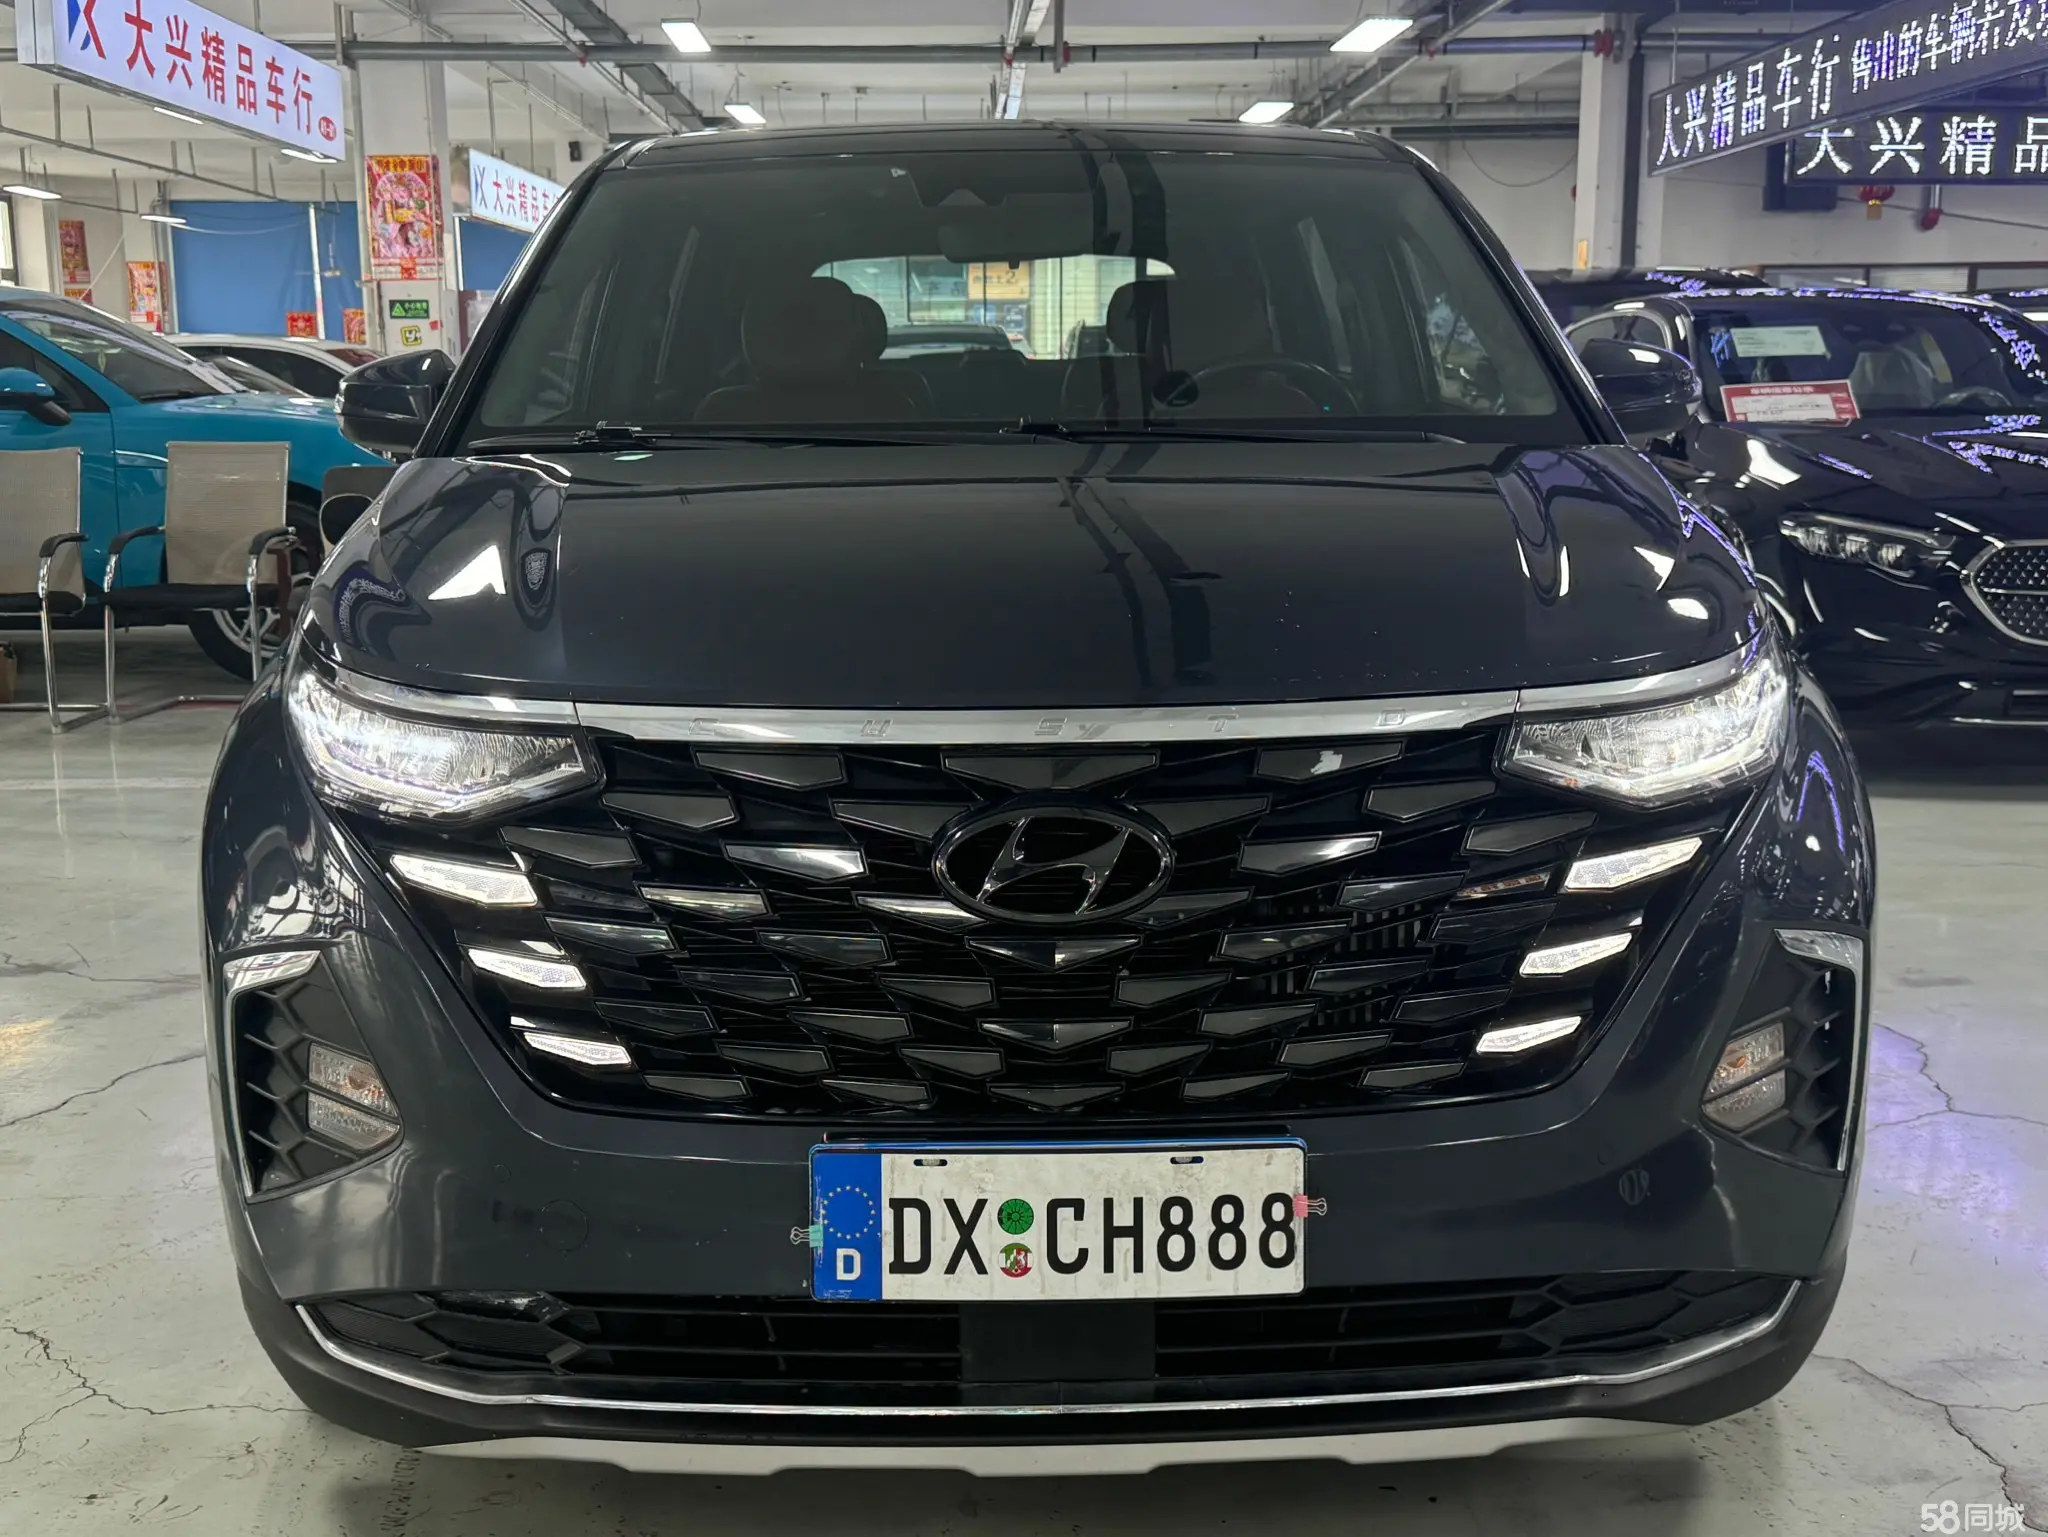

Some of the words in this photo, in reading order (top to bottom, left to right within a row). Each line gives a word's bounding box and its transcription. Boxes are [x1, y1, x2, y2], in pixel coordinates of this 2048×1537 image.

[124, 0, 313, 136] 大兴精品车行
[1796, 112, 2048, 175] 大兴精品
[492, 168, 561, 224] 大兴精品车
[836, 1247, 862, 1281] D
[889, 1197, 989, 1276] DX
[1045, 1191, 1297, 1275] CH888
